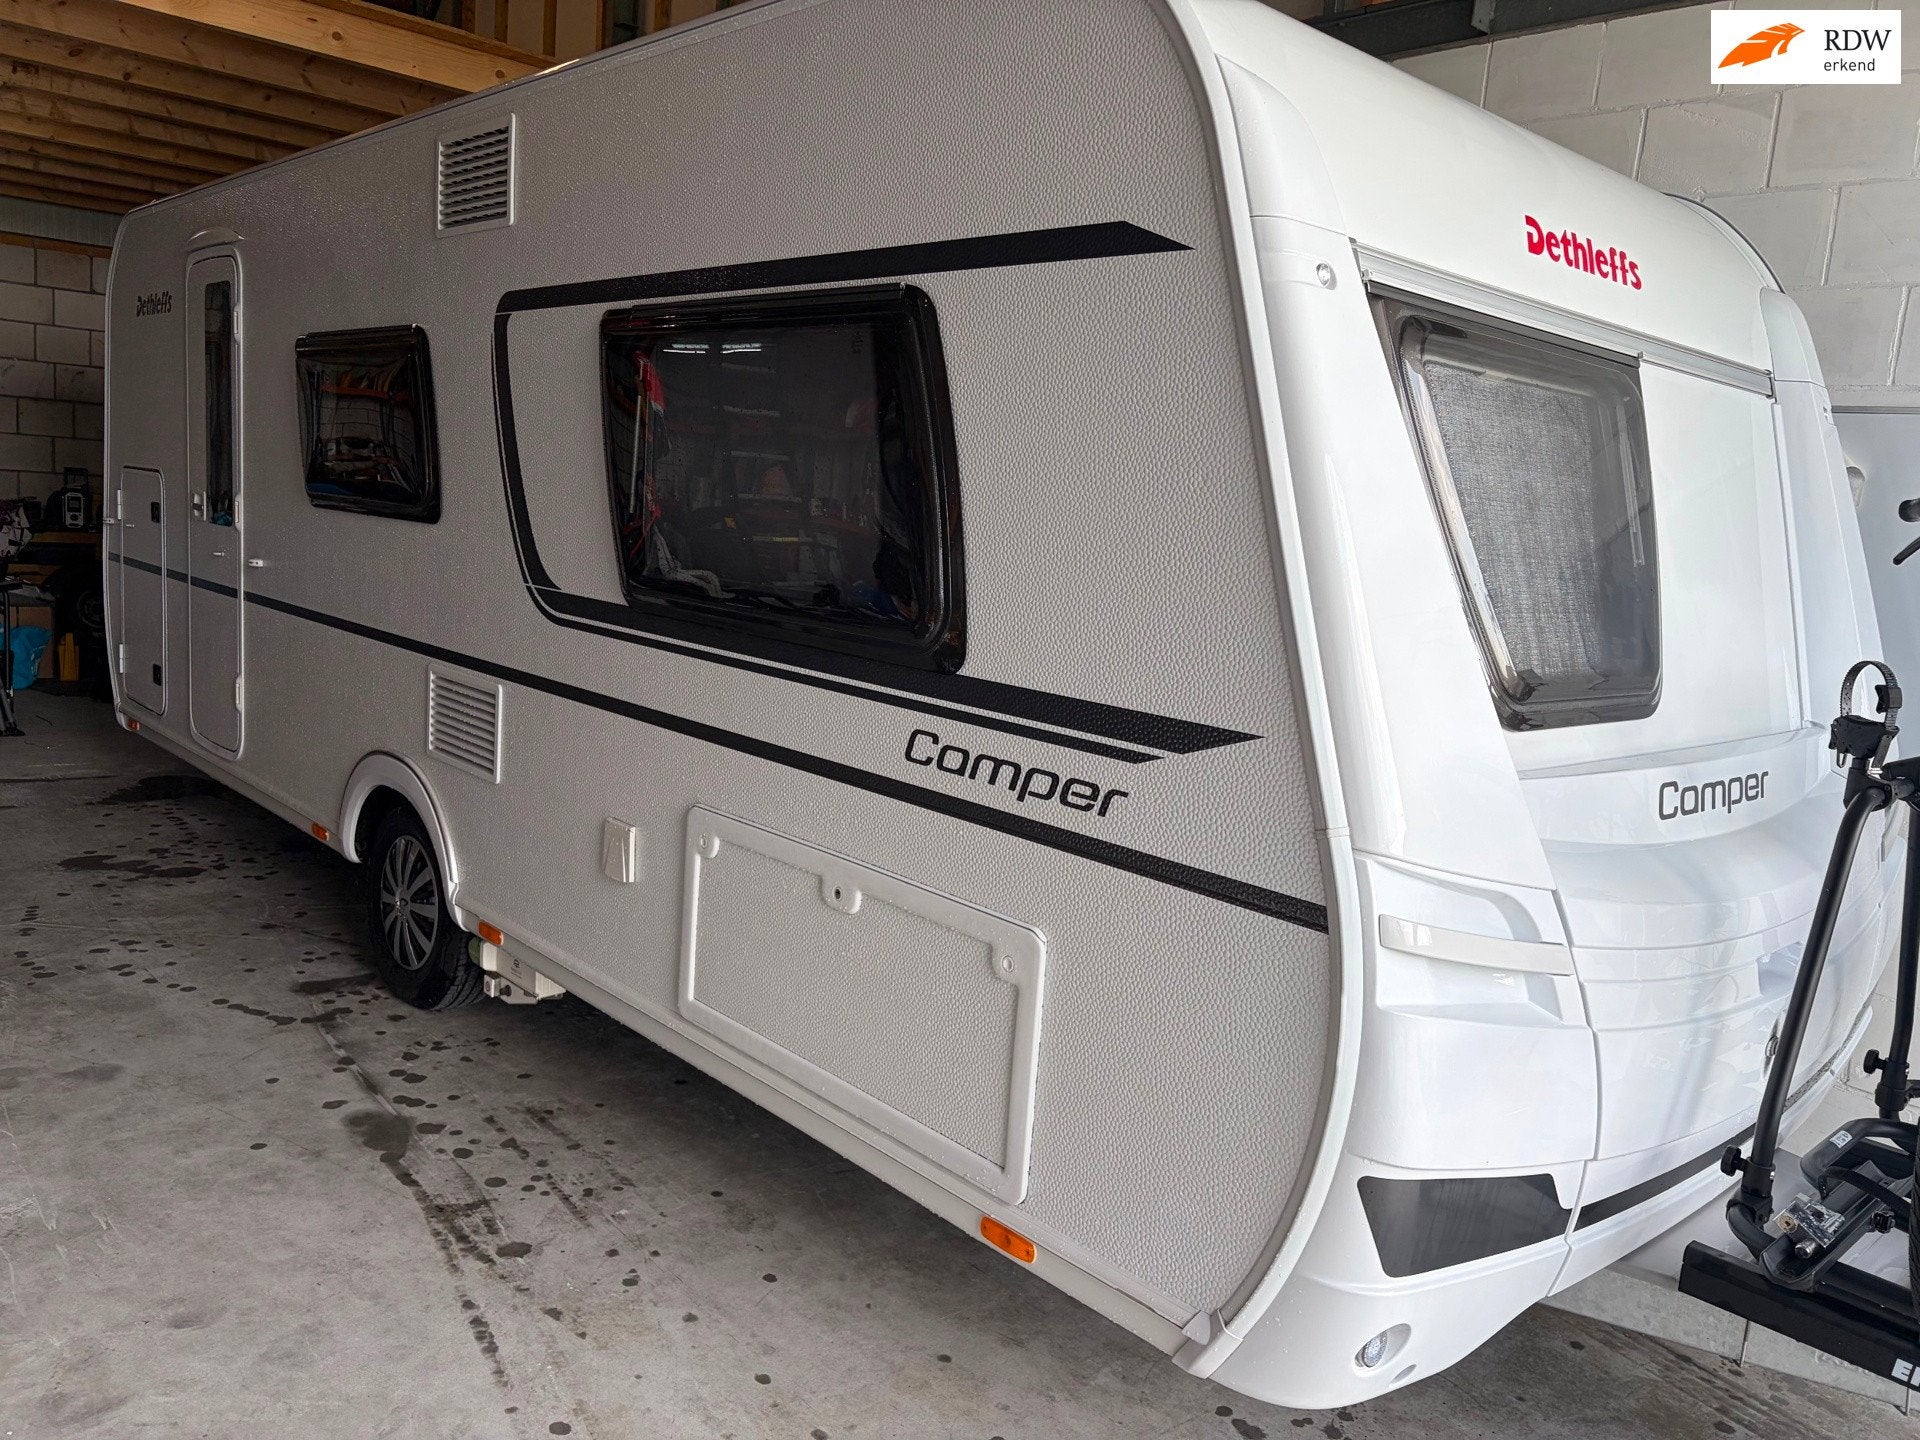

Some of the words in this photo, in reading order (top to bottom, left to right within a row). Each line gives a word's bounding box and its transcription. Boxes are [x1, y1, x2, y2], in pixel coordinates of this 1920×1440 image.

[1525, 215, 1642, 290] Dethleffs
[136, 291, 173, 317] Dethleffs
[905, 729, 1129, 817] Camper
[1659, 771, 1769, 820] Camper
